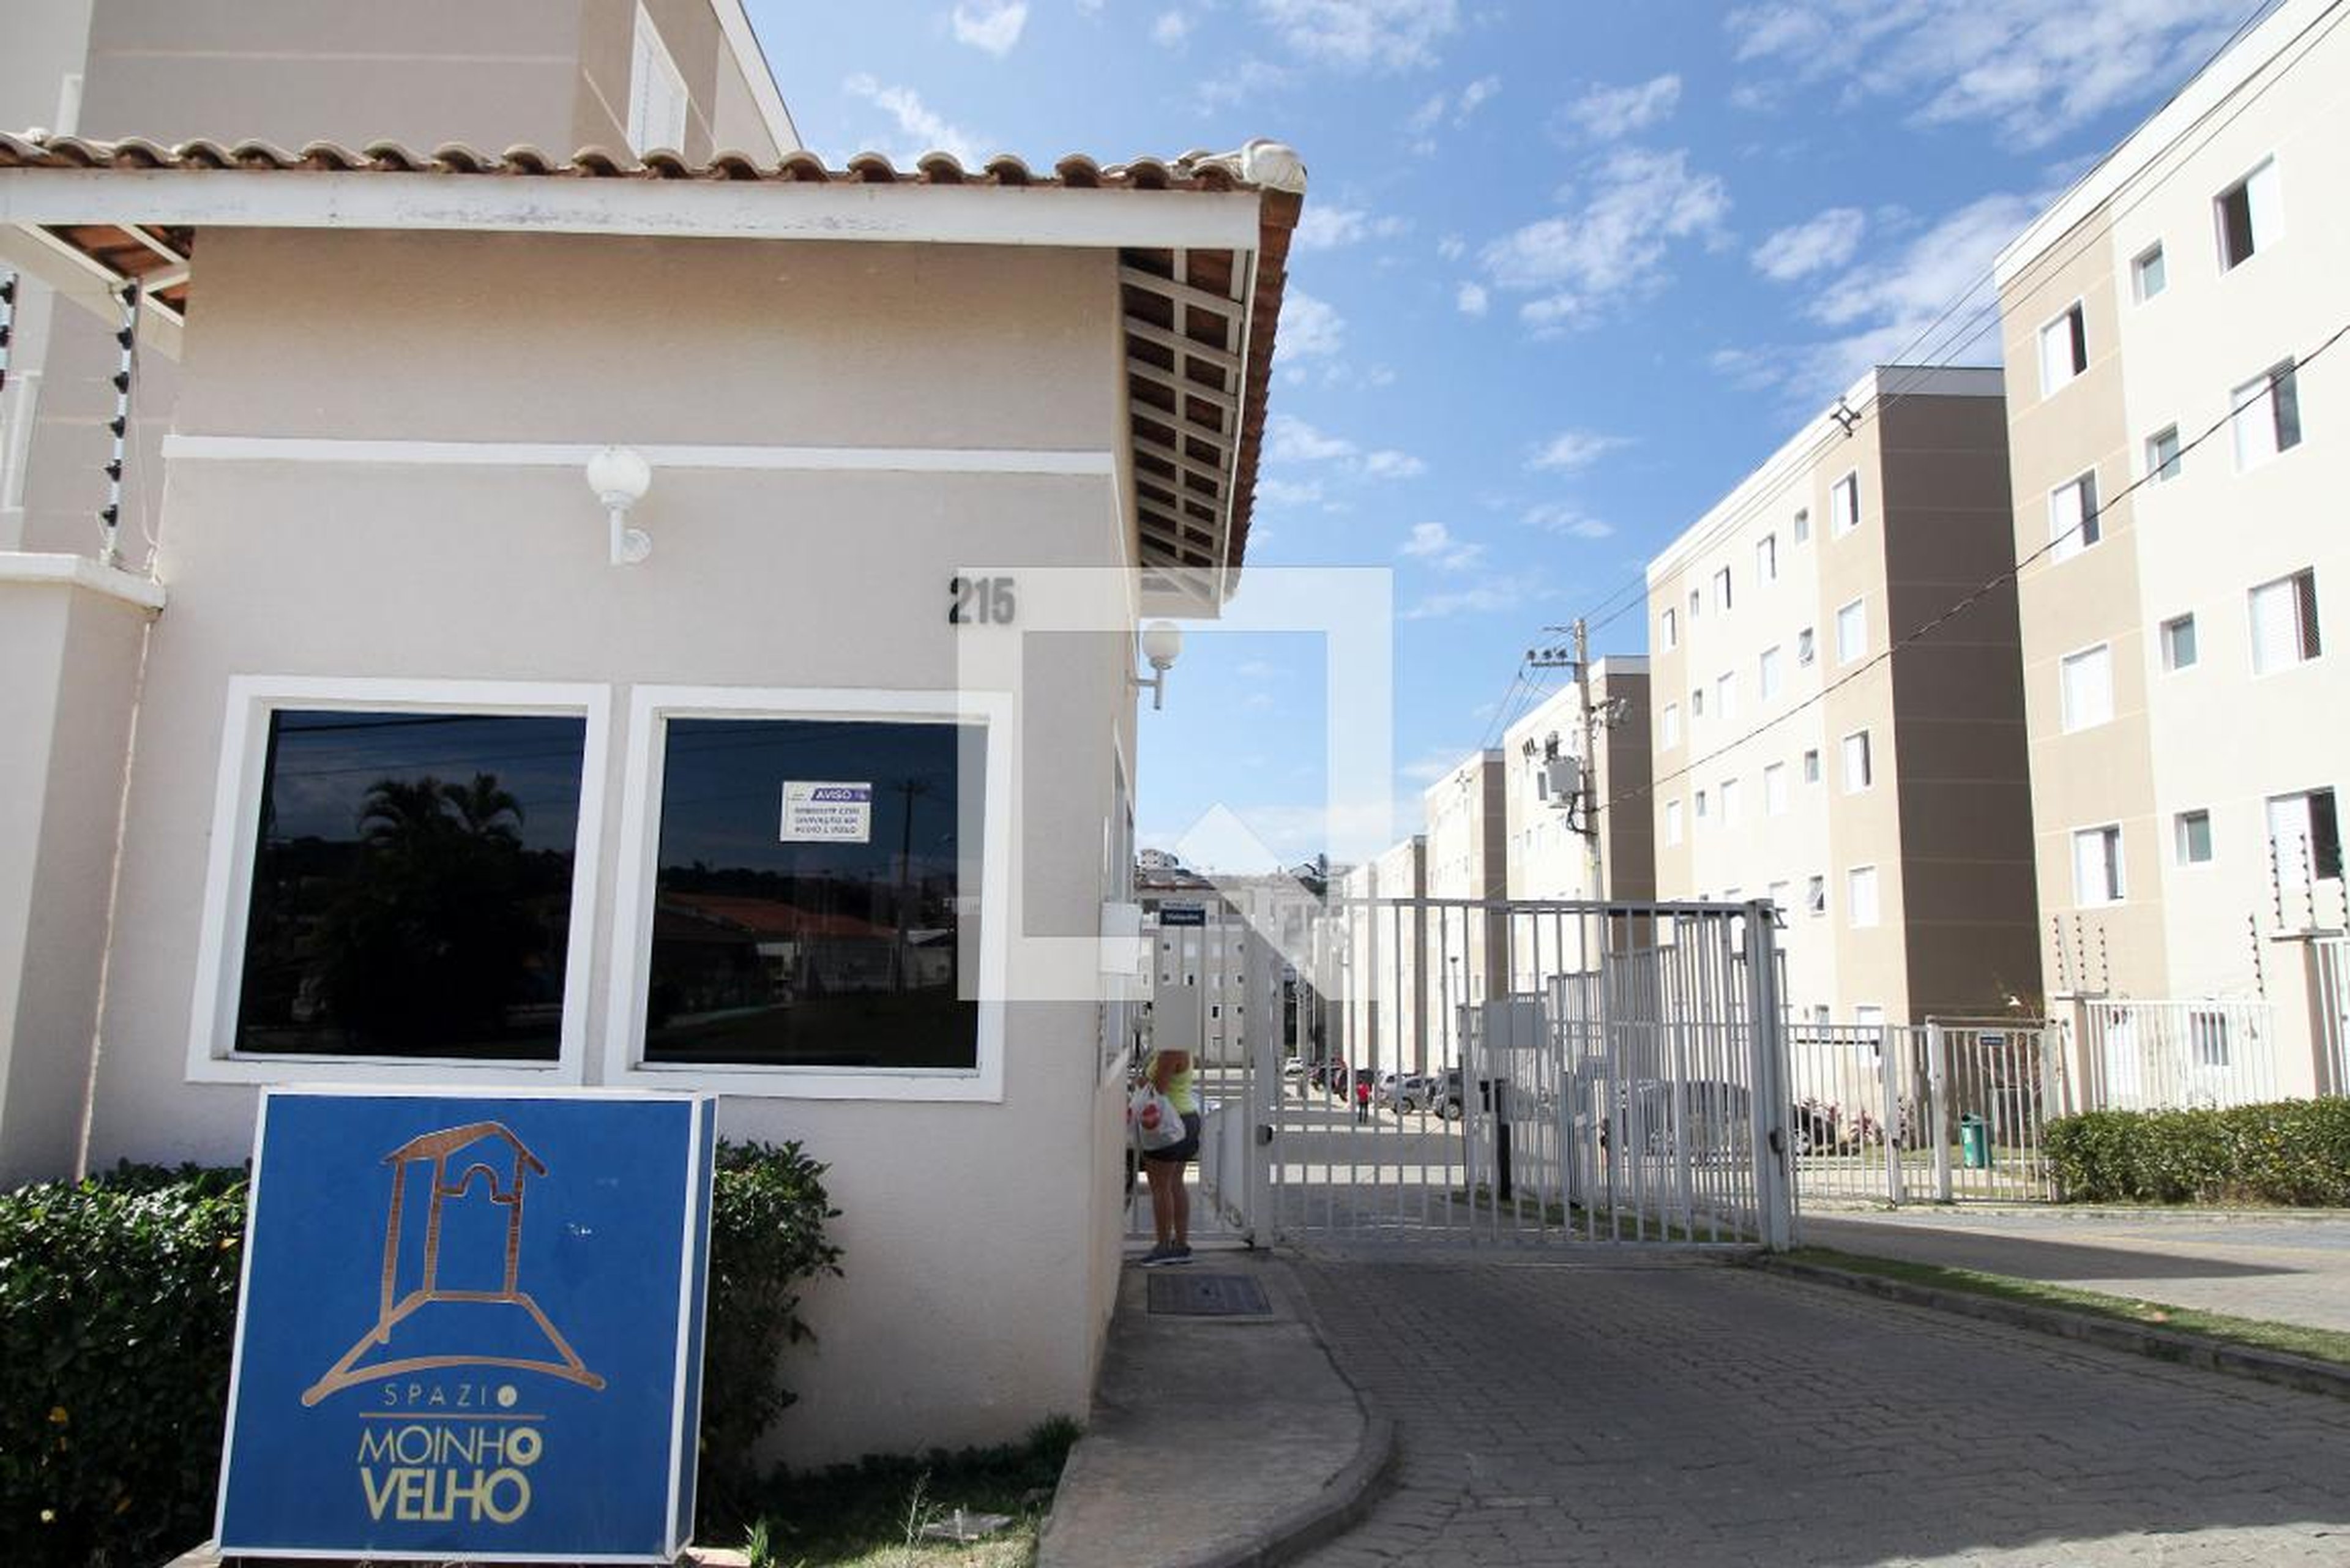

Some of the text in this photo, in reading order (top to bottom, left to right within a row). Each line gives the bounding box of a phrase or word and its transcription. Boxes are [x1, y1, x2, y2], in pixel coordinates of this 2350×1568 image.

[949, 577, 1015, 624] 215
[816, 789, 852, 800] AVISO
[384, 1383, 518, 1407] SPAZIO
[358, 1425, 543, 1466] MOINHO
[360, 1467, 531, 1524] VELHO
